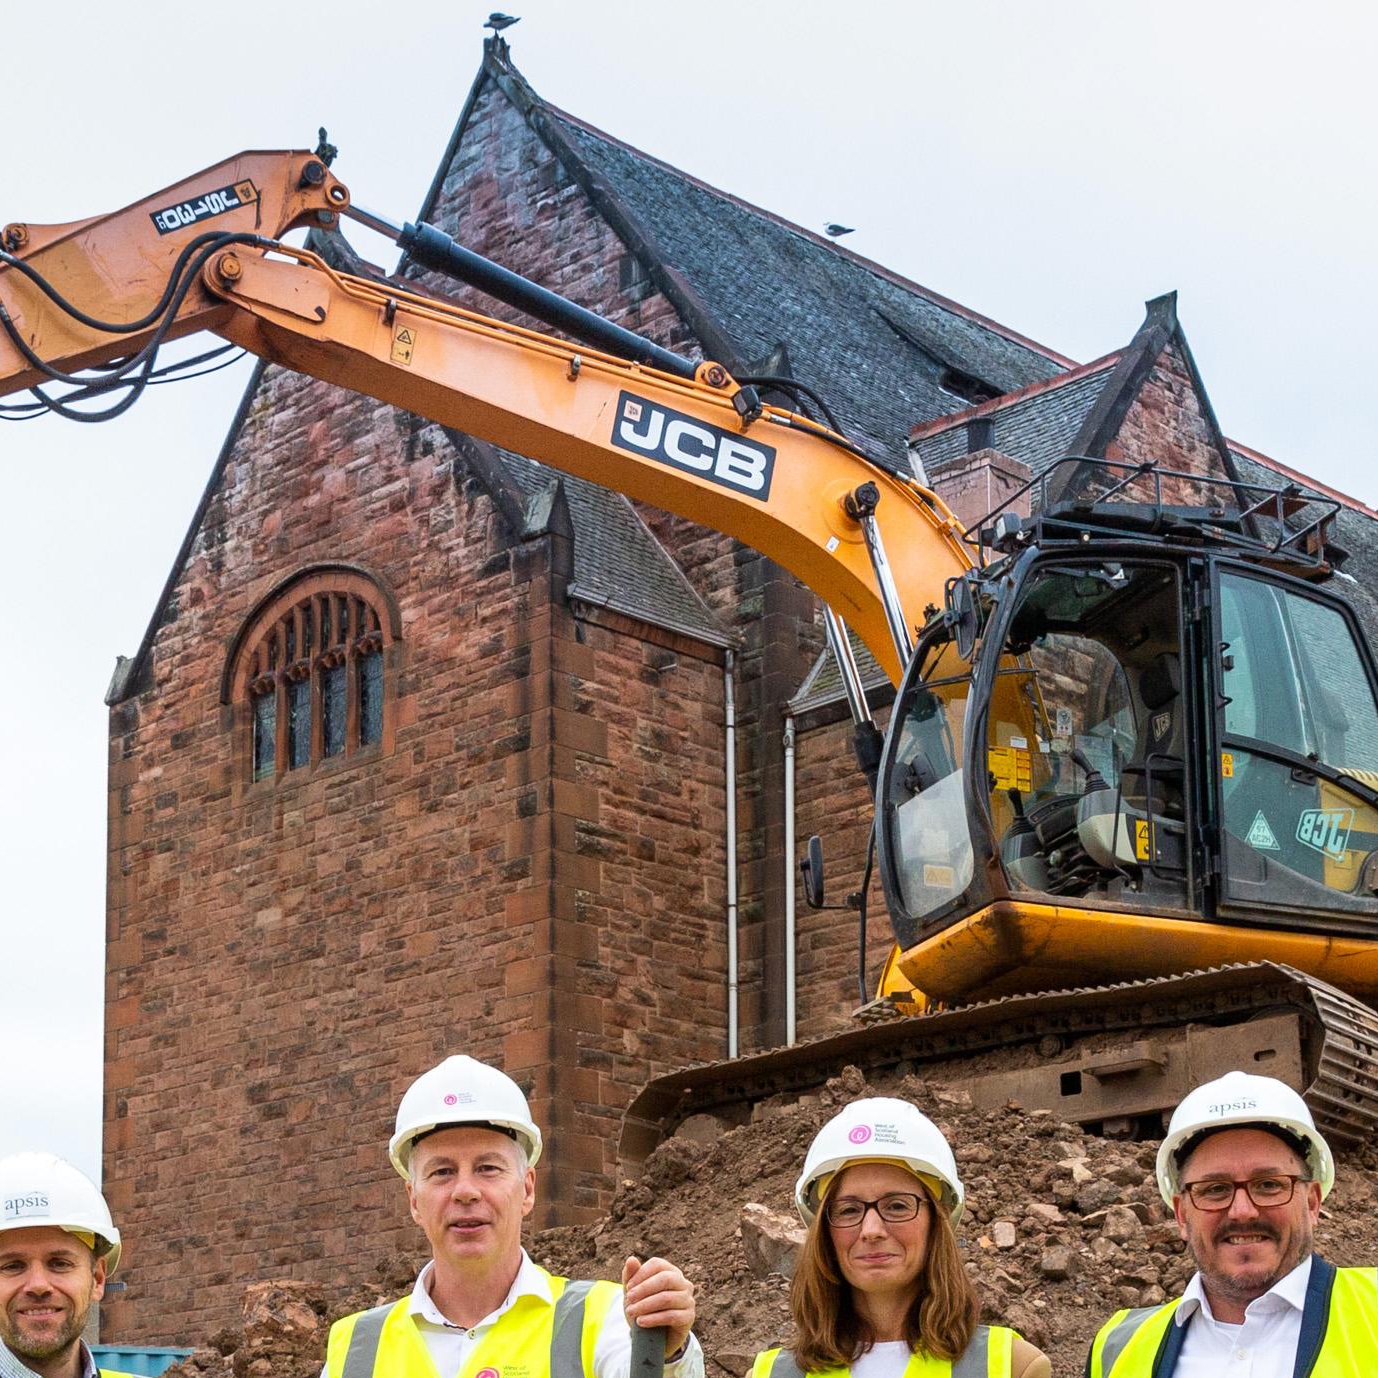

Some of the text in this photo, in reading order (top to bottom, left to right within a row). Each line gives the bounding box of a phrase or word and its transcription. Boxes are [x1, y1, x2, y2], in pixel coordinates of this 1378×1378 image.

[620, 409, 767, 491] JCB
[1209, 1100, 1257, 1117] apsis
[5, 1196, 49, 1215] apsis
